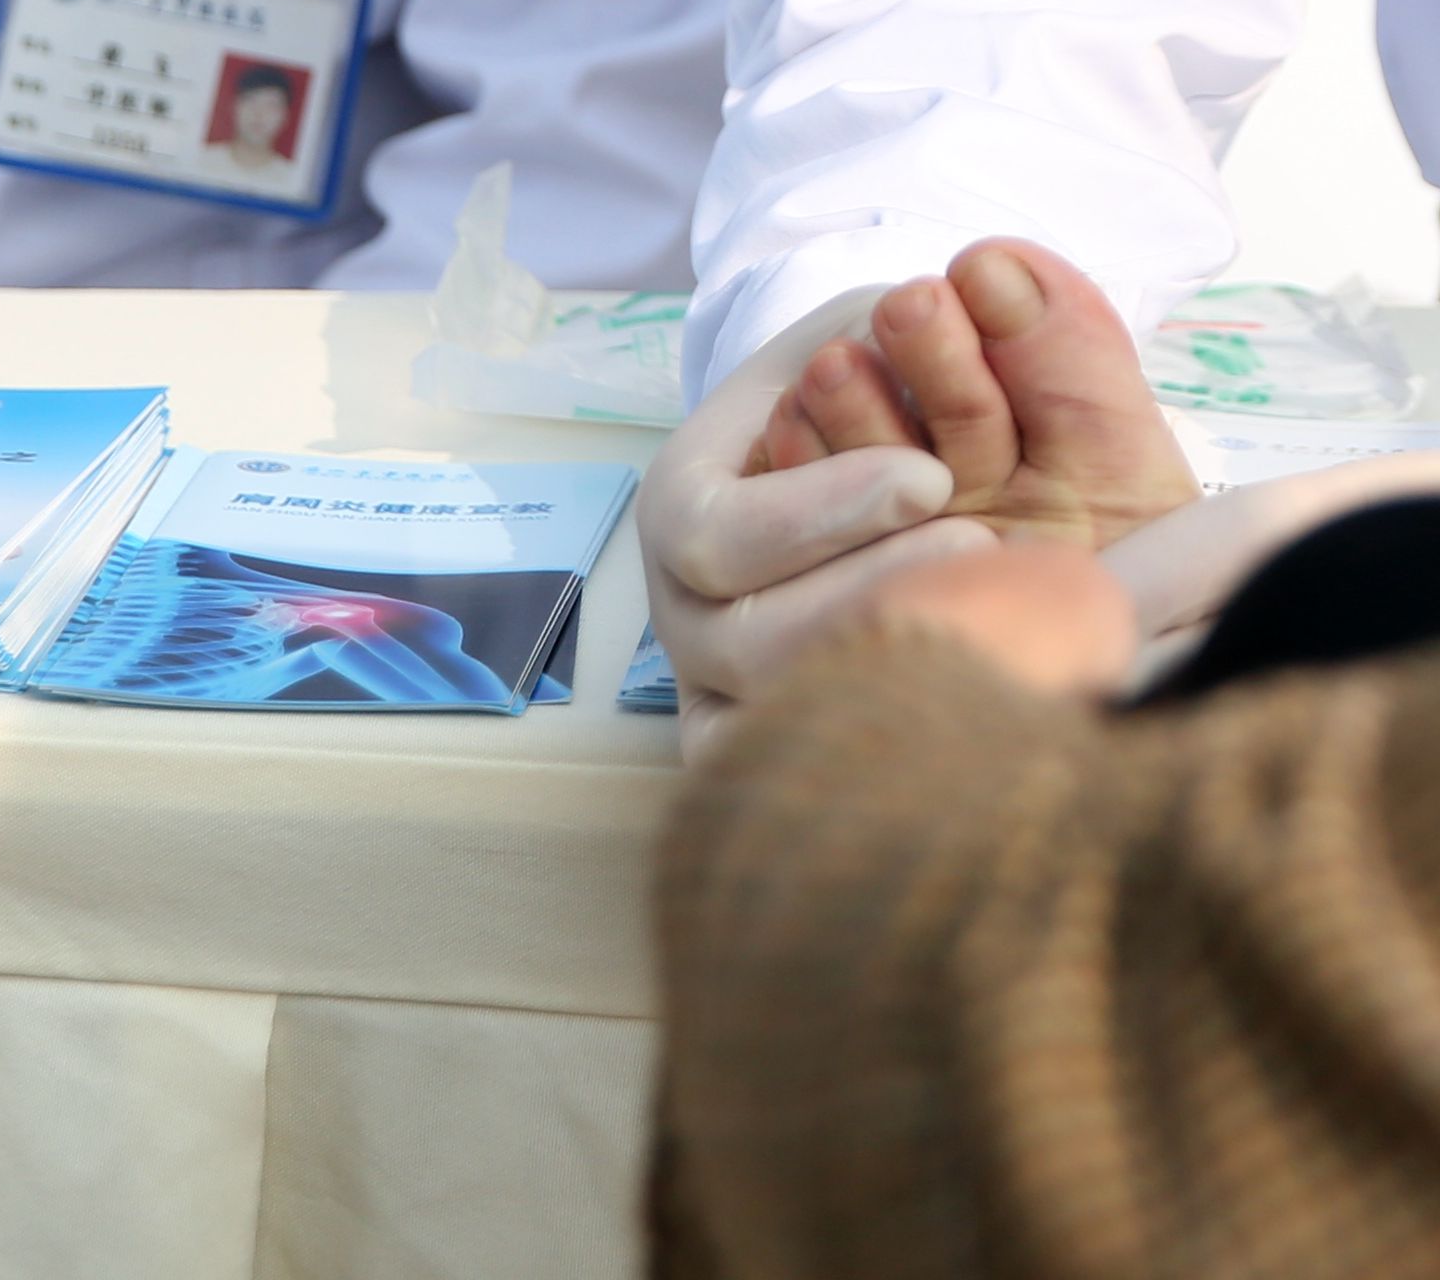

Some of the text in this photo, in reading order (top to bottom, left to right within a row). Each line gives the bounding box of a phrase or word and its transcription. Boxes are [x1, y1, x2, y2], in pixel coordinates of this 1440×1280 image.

[231, 493, 556, 514] 肩周炎健康宣教
